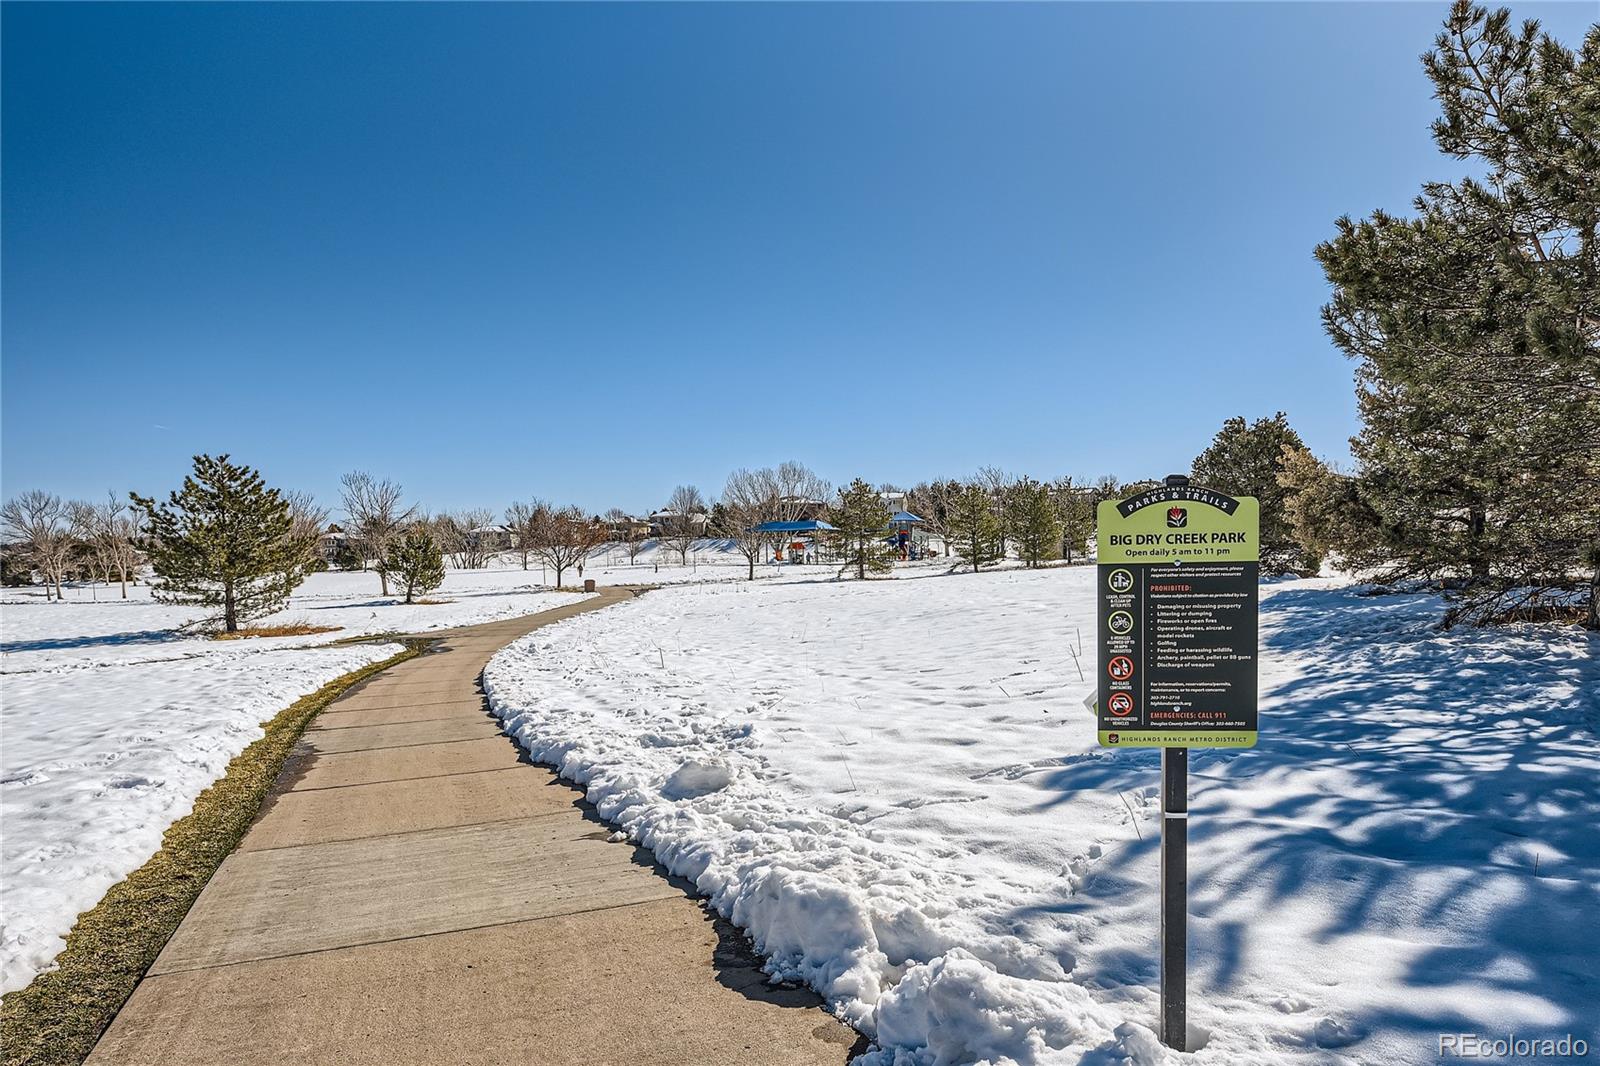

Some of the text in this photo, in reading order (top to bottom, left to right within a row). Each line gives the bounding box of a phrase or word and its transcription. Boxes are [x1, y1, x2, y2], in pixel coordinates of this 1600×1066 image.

[1147, 487, 1184, 496] HIGHLANDS
[1127, 491, 1229, 511] PARKS & TRAILS
[1110, 532, 1246, 546] BIG DRY CREEK PARK
[1125, 549, 1147, 557] Open
[1150, 548, 1170, 556] daily
[1216, 548, 1230, 556] pm
